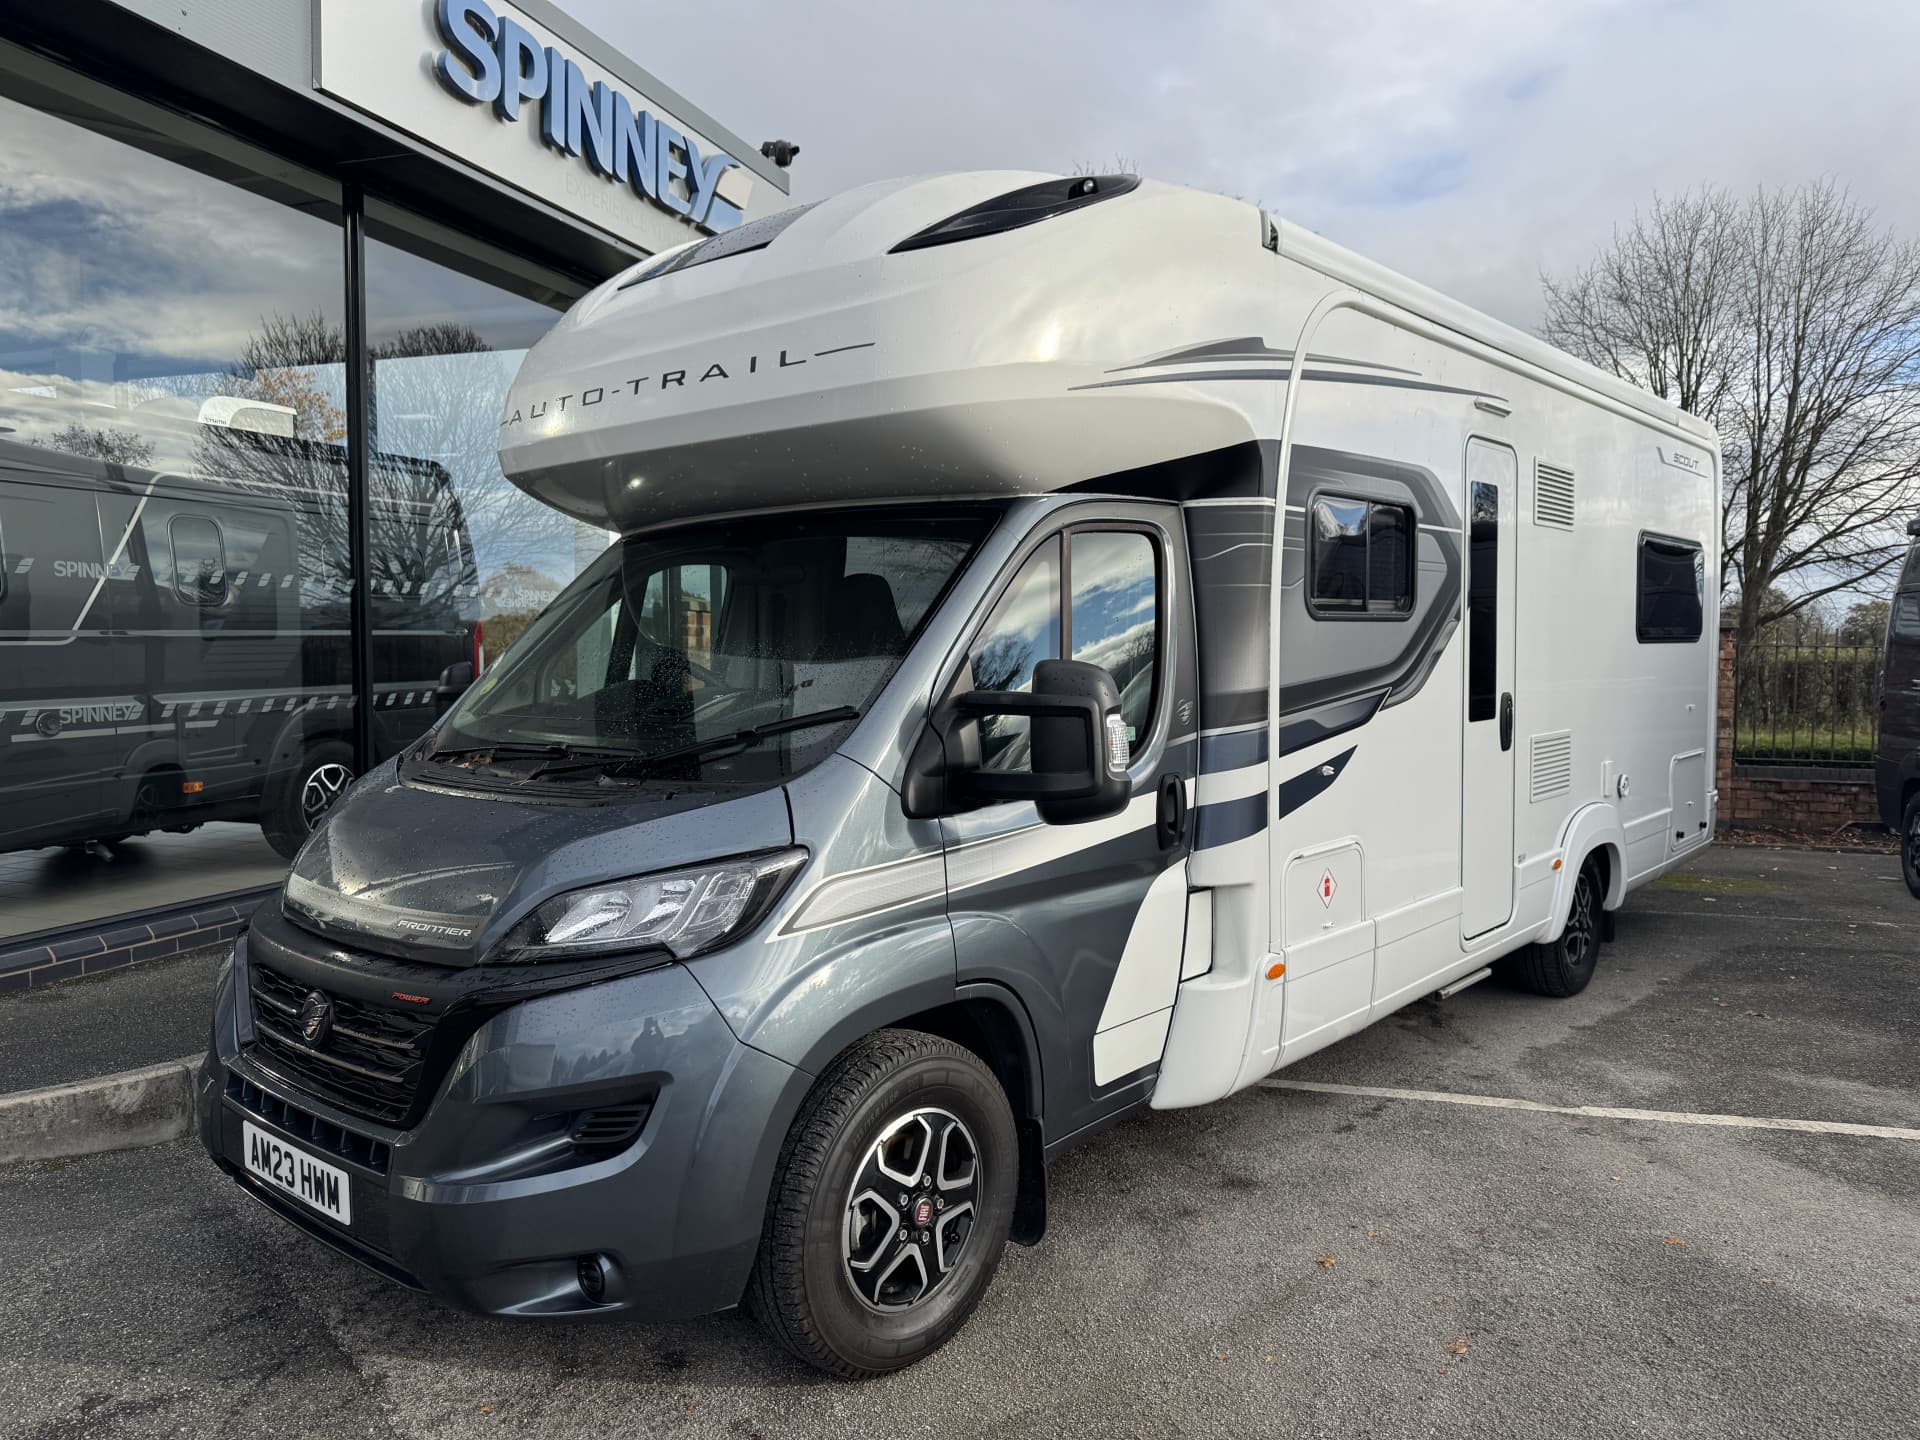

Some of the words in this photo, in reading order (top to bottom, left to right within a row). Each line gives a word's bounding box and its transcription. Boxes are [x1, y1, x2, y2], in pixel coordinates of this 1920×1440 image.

[433, 0, 741, 224] SPINNEY
[508, 350, 807, 426] AUTO-TRAIL
[1673, 452, 1700, 470] SCOUT
[53, 560, 133, 580] SPINNEY
[59, 703, 134, 724] SPINNEY
[397, 919, 473, 937] FRONTIER
[391, 991, 431, 1004] POWER
[251, 1132, 296, 1189] AM23
[300, 1158, 341, 1215] HWM
